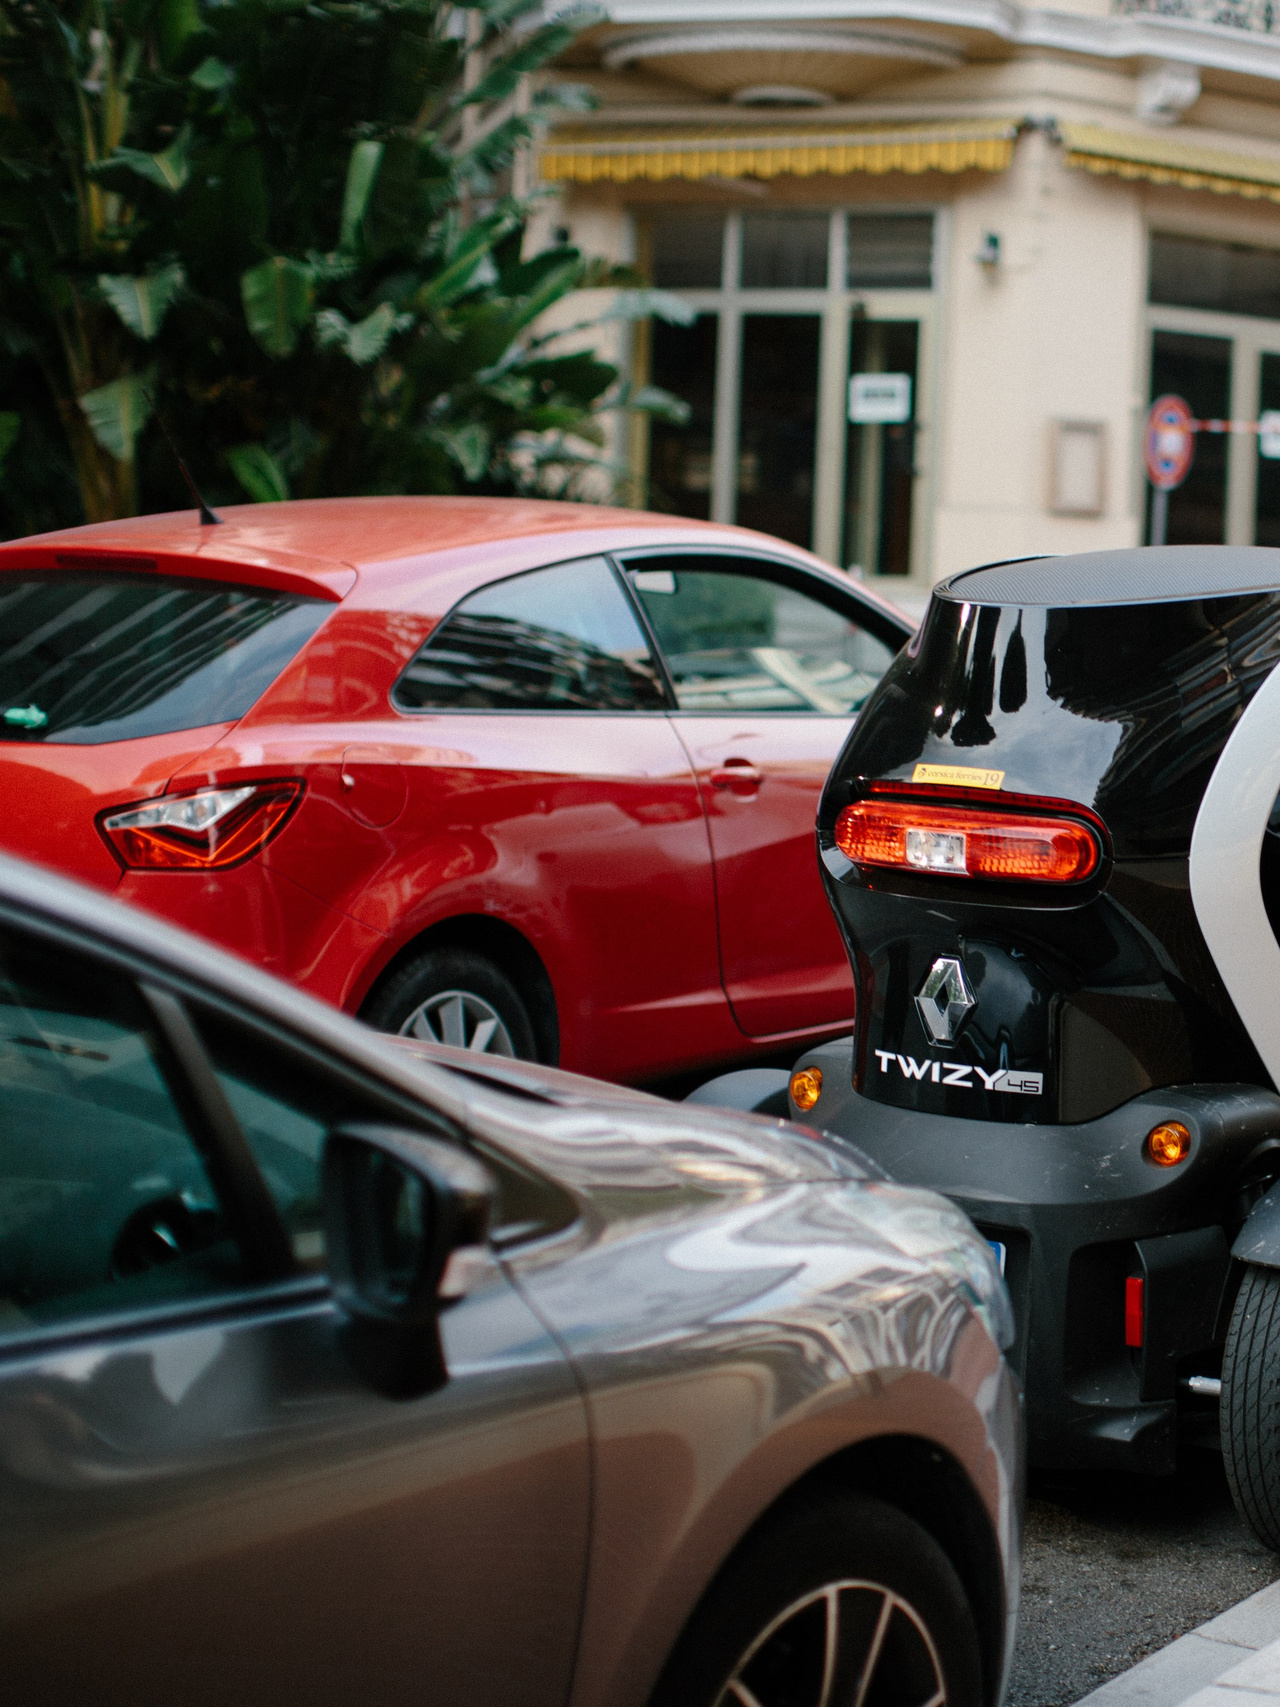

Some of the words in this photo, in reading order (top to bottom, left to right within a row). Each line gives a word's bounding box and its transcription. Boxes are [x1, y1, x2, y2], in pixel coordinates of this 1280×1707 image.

[983, 772, 1000, 787] 19
[874, 1049, 1007, 1090] TWIZY
[1007, 1078, 1040, 1093] 45
